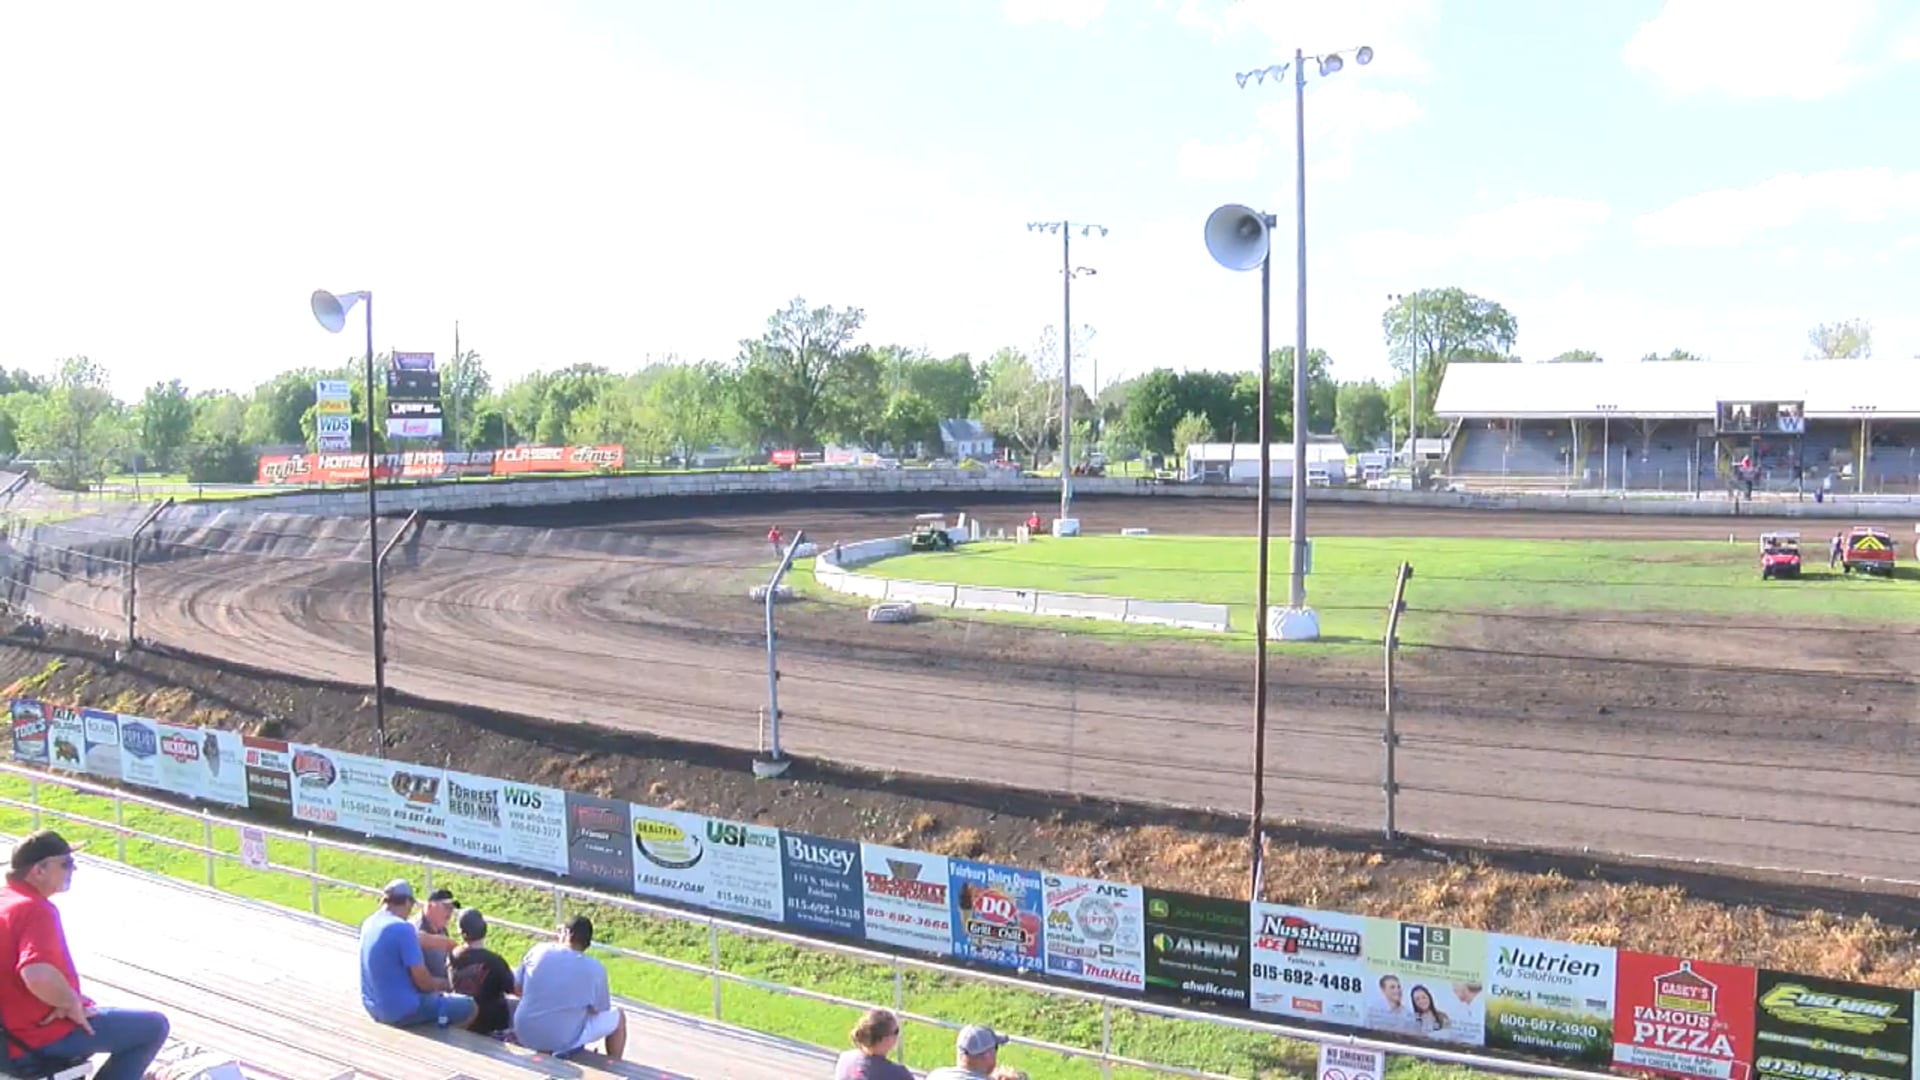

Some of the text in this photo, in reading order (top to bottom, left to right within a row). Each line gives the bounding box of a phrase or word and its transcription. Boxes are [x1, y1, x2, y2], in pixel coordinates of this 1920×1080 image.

[320, 420, 349, 433] WDS
[448, 782, 499, 804] FORREST
[503, 785, 543, 809] WDS
[706, 820, 747, 848] USI
[785, 836, 856, 876] Busey
[981, 896, 1011, 918] DQ
[1264, 916, 1359, 946] Nussbaum
[1404, 927, 1421, 957] F
[1297, 939, 1357, 953] HARDWARE
[1498, 946, 1600, 977] Nutrien
[1252, 963, 1362, 993] 815-692-4488
[1496, 966, 1513, 978] Ag
[1517, 968, 1573, 985] Solutions
[1661, 982, 1709, 999] CASEY'S
[1500, 1012, 1597, 1038] 800-667-3930
[1633, 1006, 1709, 1028] FAMOUS
[1633, 1020, 1735, 1057] PIZZA
[1327, 1048, 1338, 1057] NO
